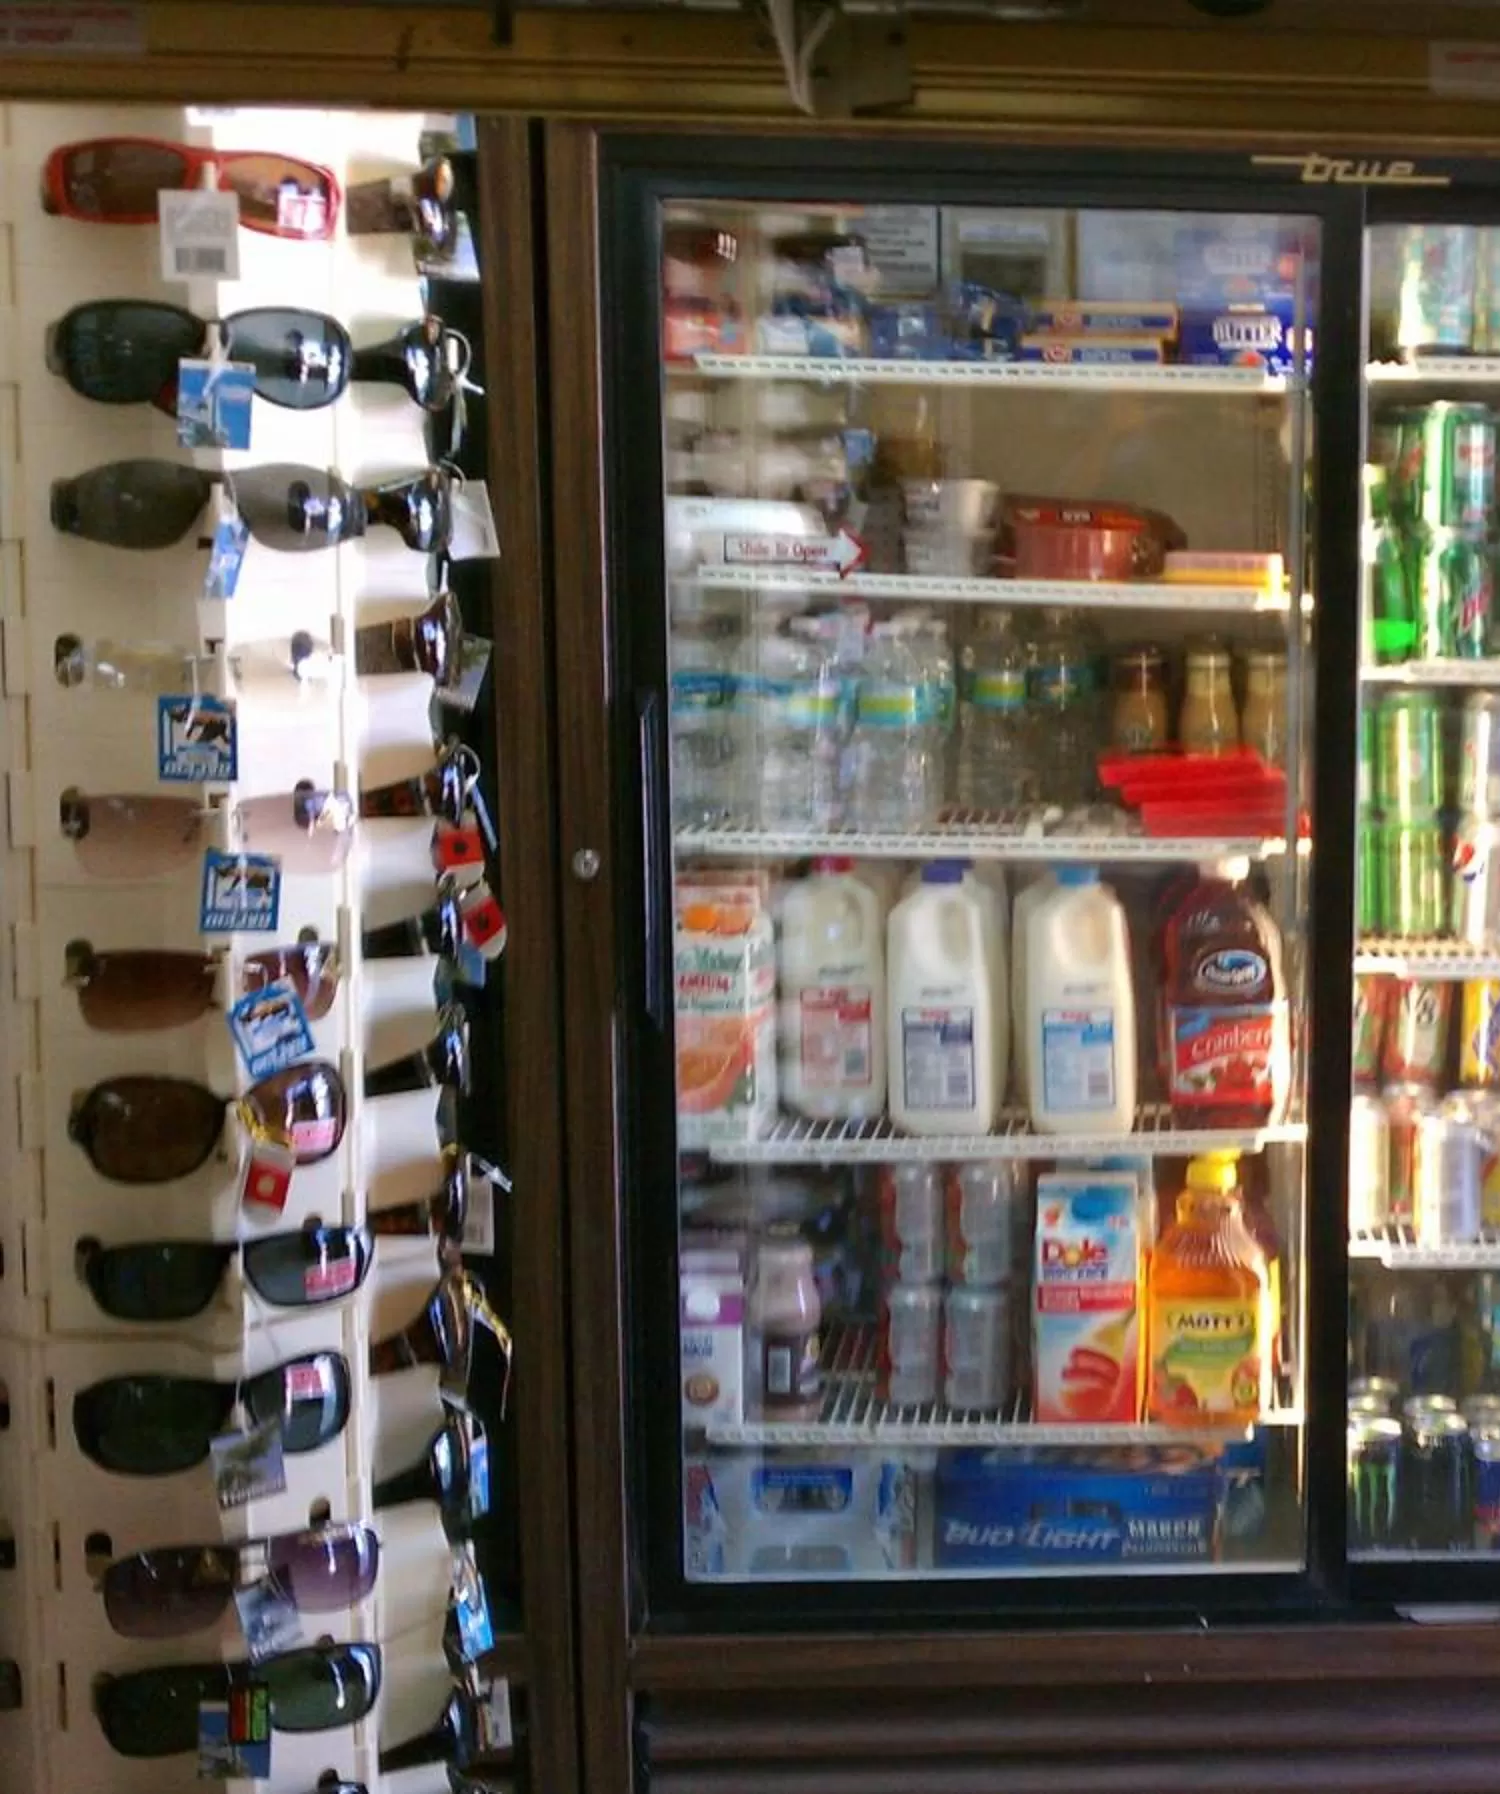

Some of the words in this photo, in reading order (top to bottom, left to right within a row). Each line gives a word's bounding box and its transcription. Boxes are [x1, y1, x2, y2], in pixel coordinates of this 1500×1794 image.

[791, 541, 828, 563] Open
[1042, 1237, 1110, 1267] Dole
[942, 1516, 1015, 1548] BUD
[1025, 1518, 1123, 1552] LIGHT
